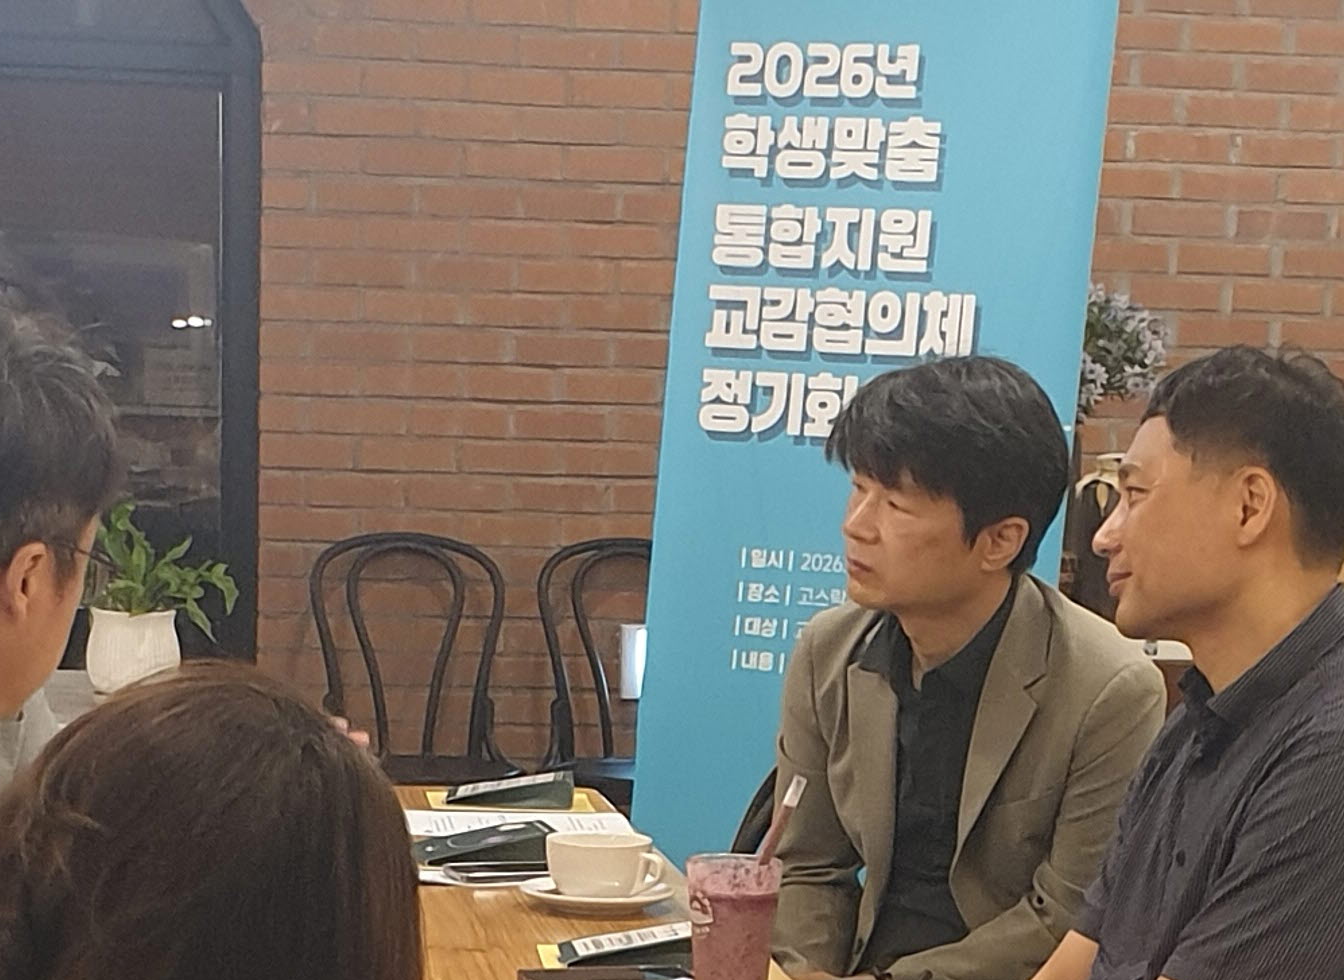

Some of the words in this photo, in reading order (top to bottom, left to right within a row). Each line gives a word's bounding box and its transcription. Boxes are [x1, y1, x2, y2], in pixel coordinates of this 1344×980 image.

[726, 41, 921, 100] 2026년
[721, 113, 942, 183] 학생맞춤
[711, 203, 933, 274] 통합지원
[704, 284, 977, 358] 교감협의체
